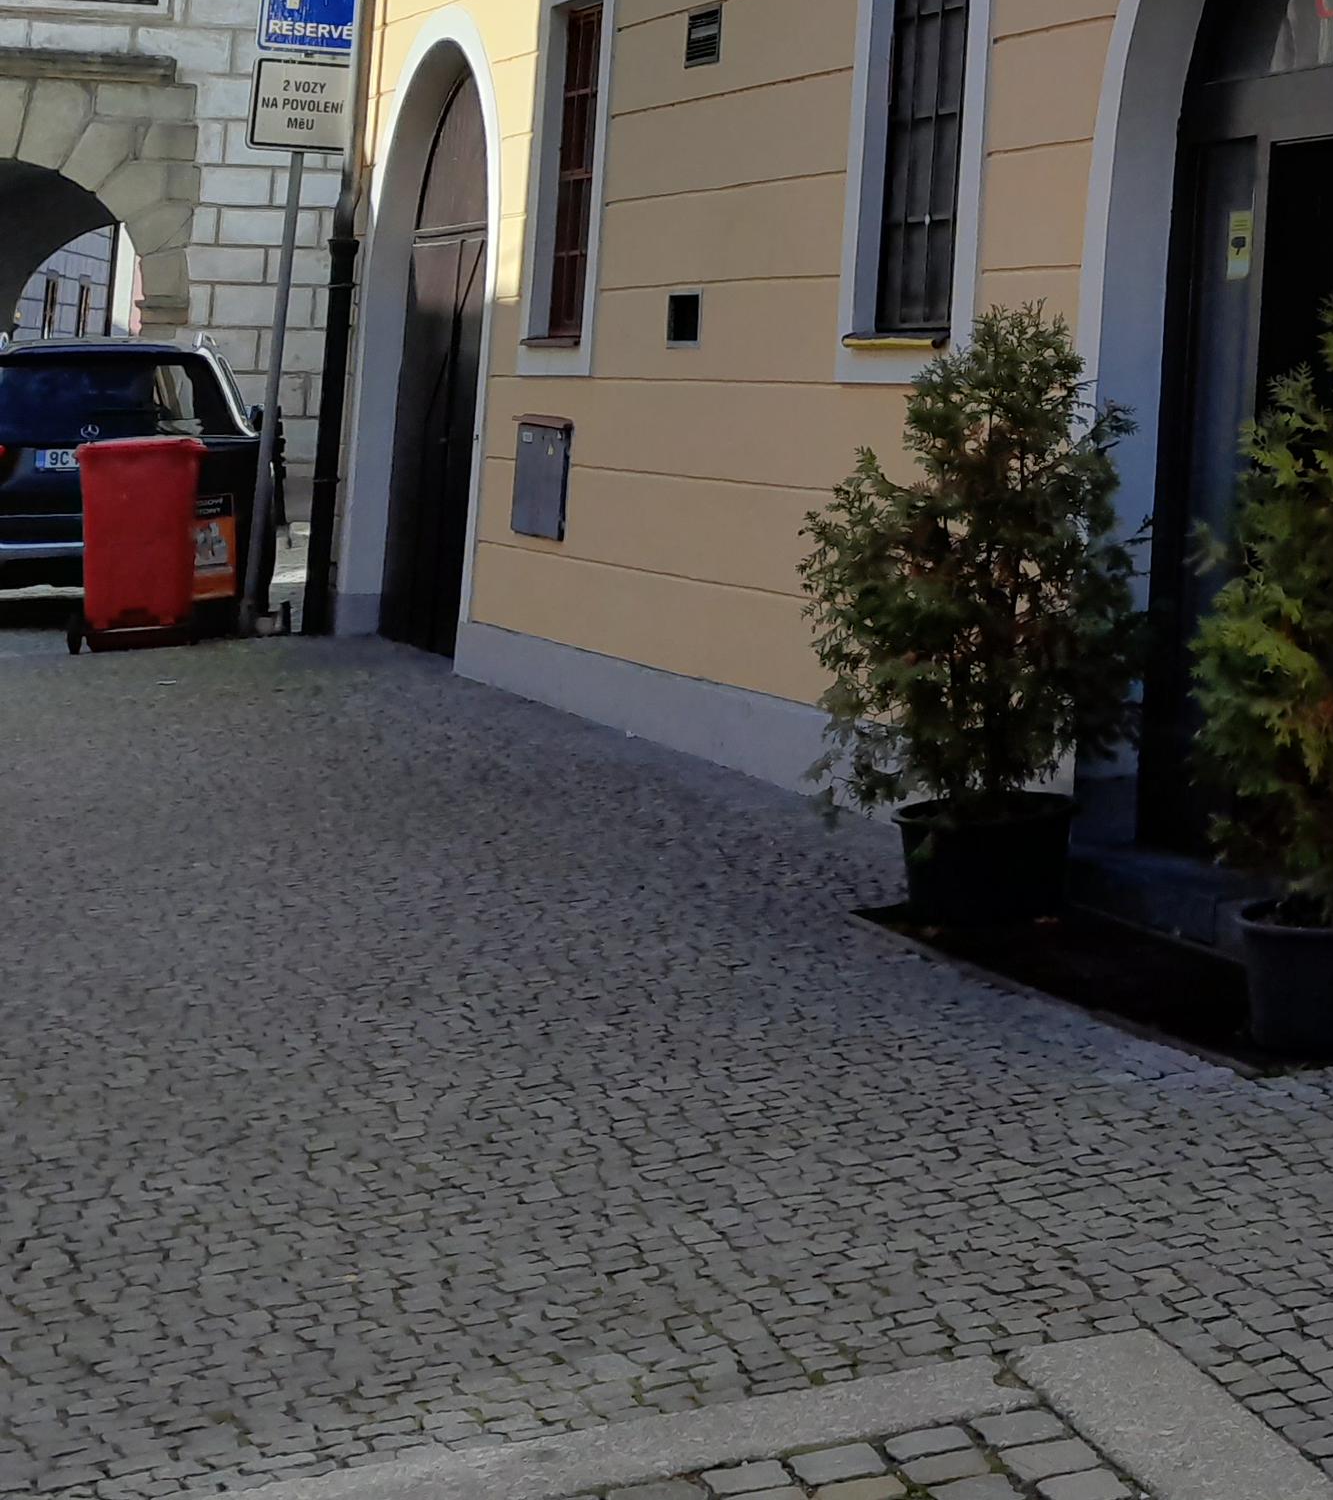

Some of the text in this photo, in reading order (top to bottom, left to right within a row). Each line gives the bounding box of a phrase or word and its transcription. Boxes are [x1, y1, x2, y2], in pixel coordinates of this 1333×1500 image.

[282, 79, 327, 95] 2 VOZY
[261, 97, 344, 115] NA POVOLENÍ
